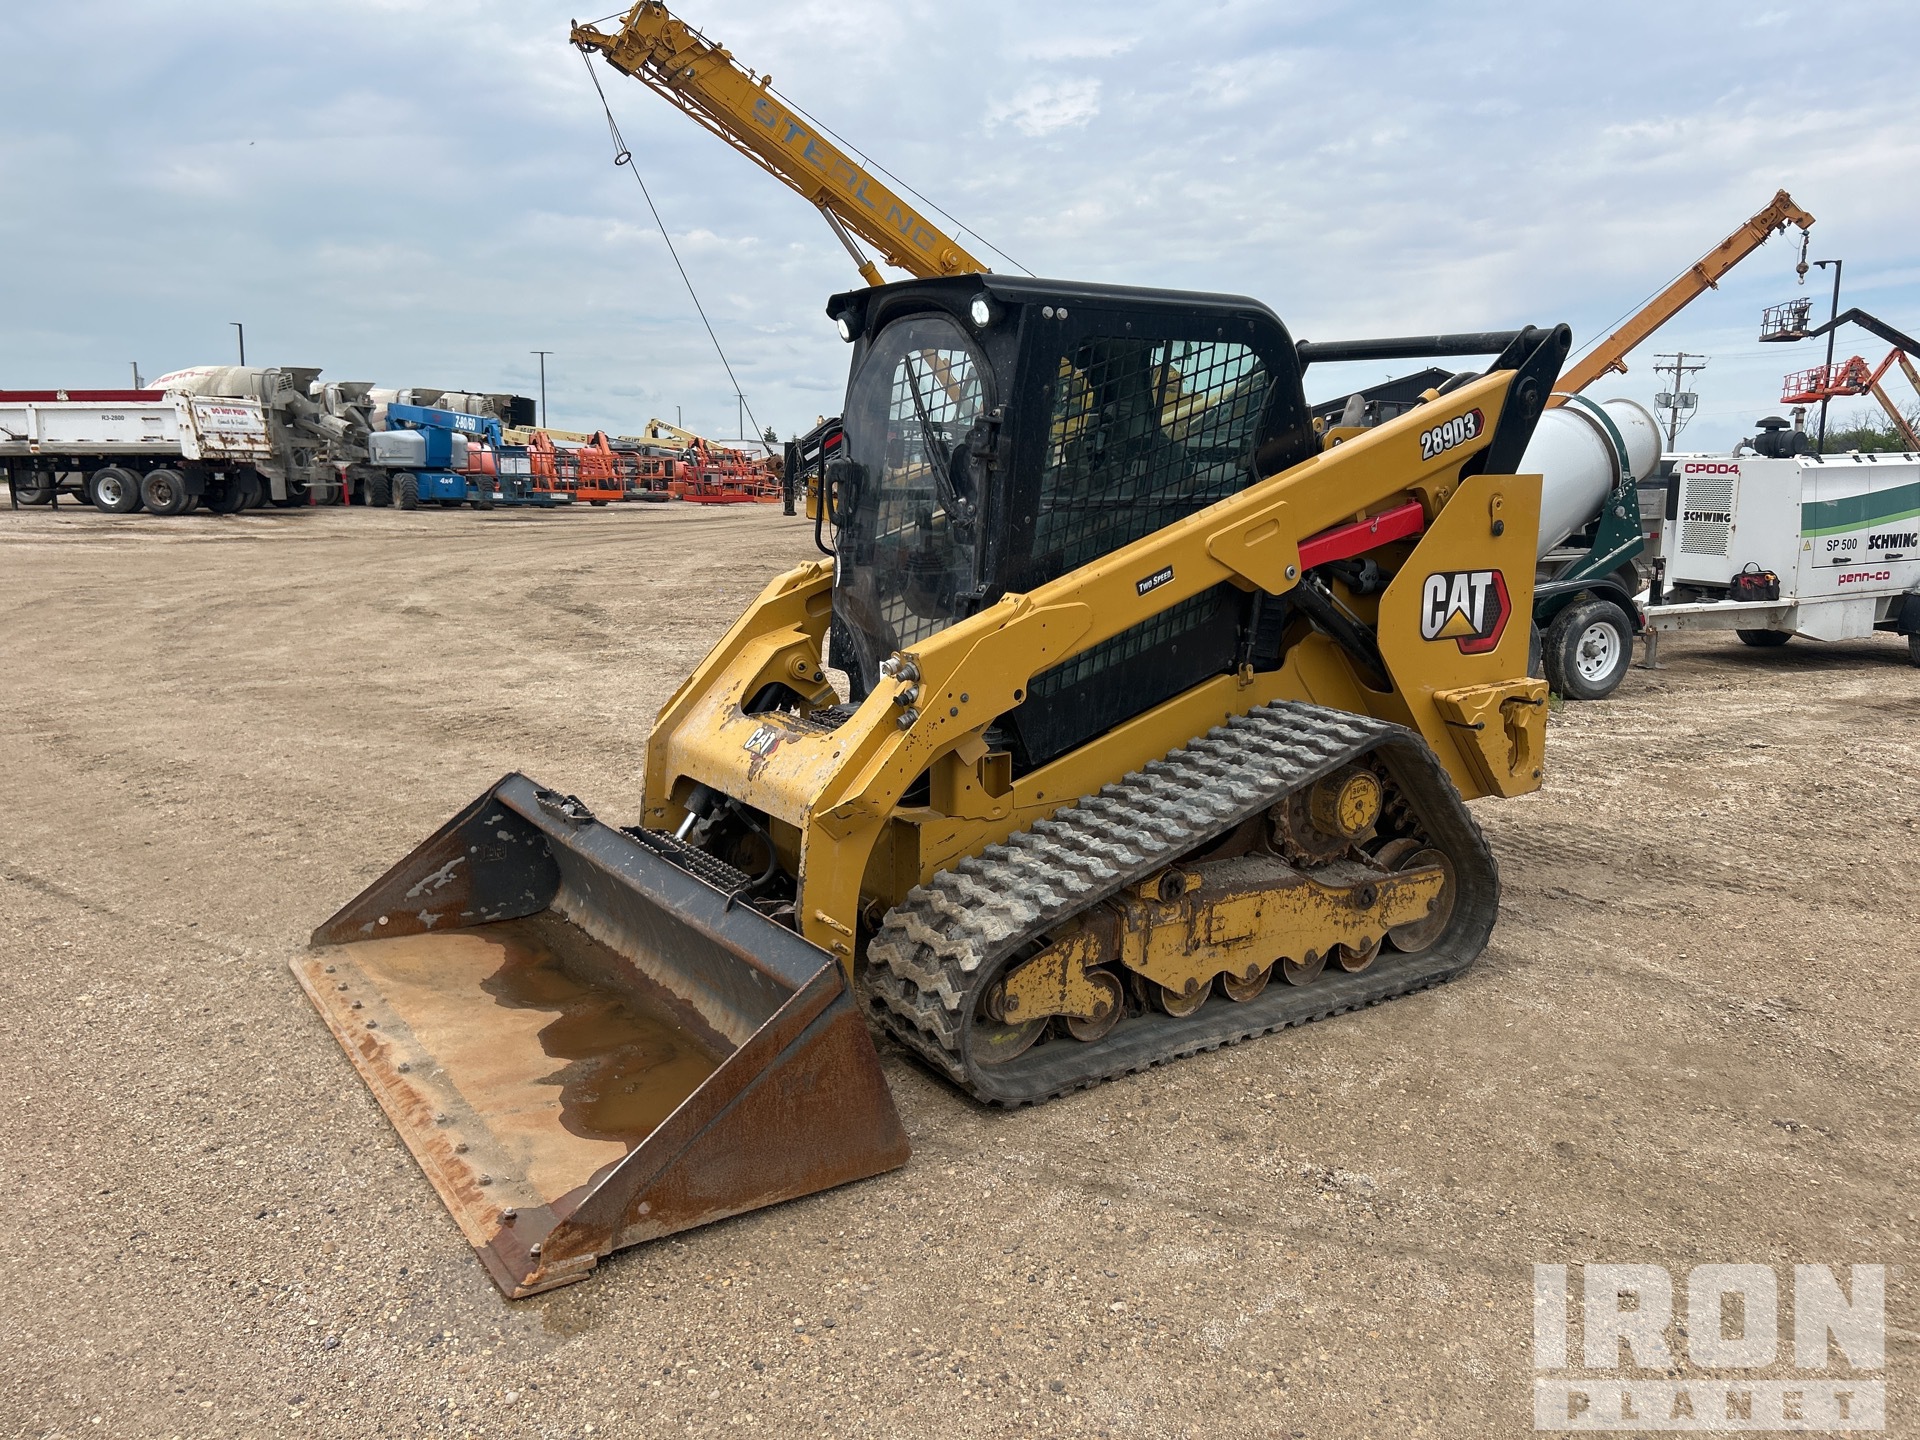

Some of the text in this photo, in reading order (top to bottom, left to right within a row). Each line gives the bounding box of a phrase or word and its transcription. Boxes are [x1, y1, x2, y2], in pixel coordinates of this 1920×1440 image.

[751, 97, 937, 252] STERLNG
[1421, 412, 1476, 460] 289D3
[1684, 463, 1740, 475] CP004
[1683, 511, 1731, 523] SCHWING
[1826, 538, 1858, 552] SP 500
[1868, 532, 1918, 550] SCHWING
[1138, 570, 1172, 593] TWO SPEED
[1837, 570, 1891, 587] penn-co
[1422, 571, 1493, 639] CAT
